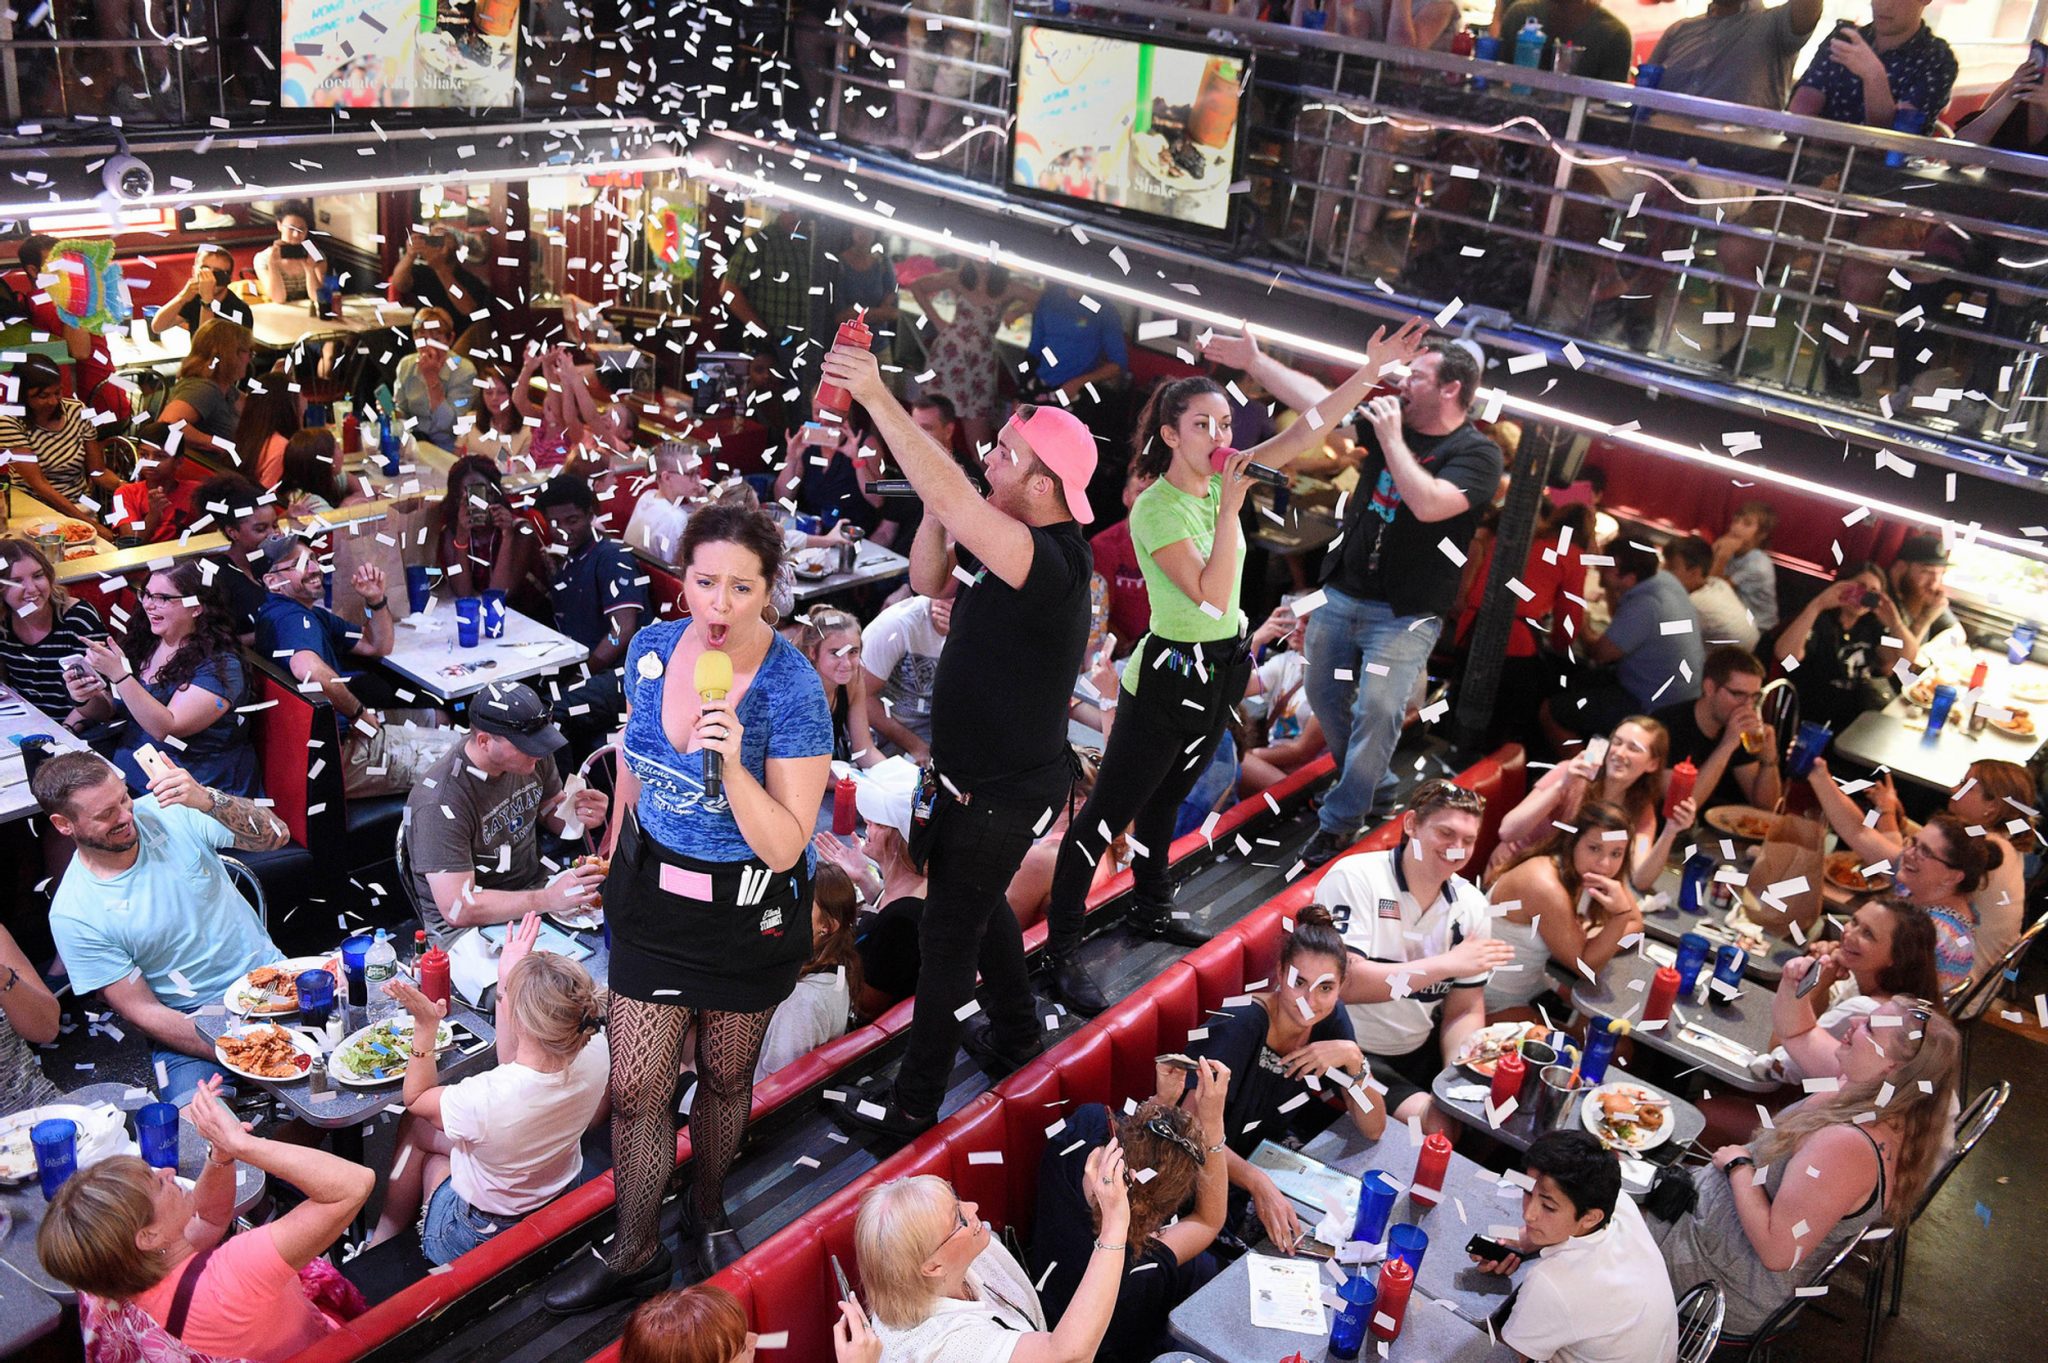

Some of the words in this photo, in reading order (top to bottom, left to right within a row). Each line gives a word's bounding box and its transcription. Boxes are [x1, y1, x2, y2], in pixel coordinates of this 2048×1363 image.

[423, 74, 465, 90] Shake
[1134, 174, 1177, 198] Shake
[482, 786, 543, 845] CAYMAN
